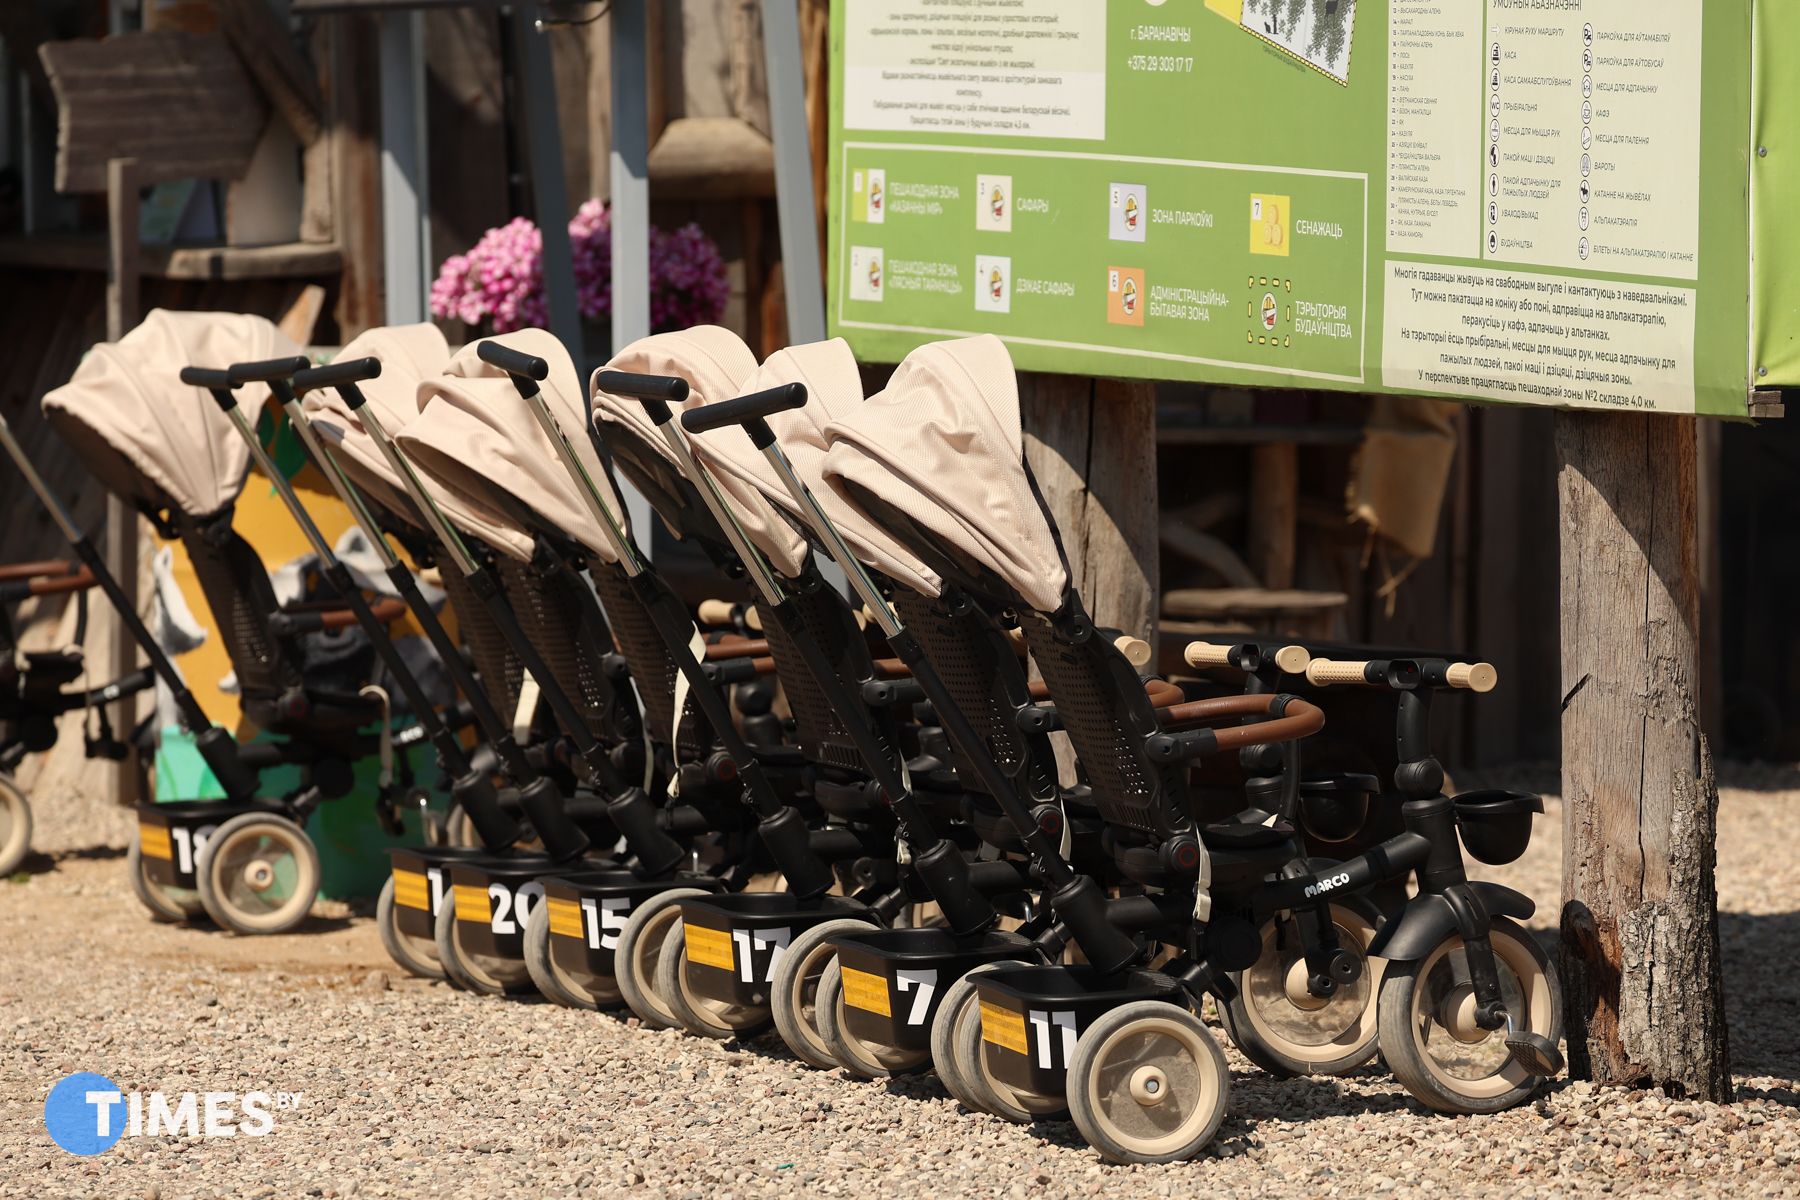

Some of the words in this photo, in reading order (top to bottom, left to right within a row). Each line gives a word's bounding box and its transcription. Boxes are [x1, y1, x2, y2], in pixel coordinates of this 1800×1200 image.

[1395, 266, 1417, 279] Многія
[1419, 271, 1455, 284] гадаванцы
[1457, 274, 1484, 287] жывуць
[1486, 277, 1494, 286] на
[1496, 277, 1535, 291] свабодным
[1537, 282, 1562, 295] выгуле
[1568, 285, 1616, 300] кантактуюць
[1623, 290, 1687, 305] наведвальнікамі.
[1411, 287, 1422, 302] Тут
[1424, 291, 1446, 302] можна
[1448, 294, 1483, 307] пакатацца
[1485, 298, 1494, 306] на
[1495, 297, 1518, 312] коніку
[1519, 299, 1532, 311] або
[1534, 301, 1550, 314] поні,
[1552, 304, 1594, 318] адправіцца
[1595, 309, 1604, 318] на
[1606, 310, 1666, 327] альпакатэрапію,
[1462, 315, 1500, 328] перакусіць
[1508, 318, 1526, 332] кафэ,
[1528, 322, 1564, 335] адпачыць
[1571, 326, 1610, 339] альтанках.
[1401, 327, 1410, 339] На
[1411, 331, 1446, 345] тэрыторыі
[1448, 332, 1464, 346] ёсць
[1466, 335, 1510, 352] прыбіральні,
[1512, 342, 1536, 354] месцы
[1537, 345, 1550, 355] для
[1552, 346, 1577, 358] мыцця
[1579, 349, 1593, 361] рук,
[1595, 351, 1618, 363] месца
[1620, 354, 1660, 369] адпачынку
[1662, 358, 1675, 369] для
[1440, 354, 1472, 366] пажылых
[1474, 357, 1502, 371] людзей,
[1504, 360, 1522, 372] пакоі
[1525, 362, 1541, 375] маці
[1546, 364, 1574, 379] дзіцяці,
[1575, 367, 1610, 381] дзіцячыя
[1611, 373, 1632, 384] зоны.
[1425, 372, 1470, 385] перспектыве
[1471, 377, 1517, 392] працягласць
[1518, 383, 1562, 396] пешаходнай
[1564, 389, 1583, 399] зоны
[1585, 388, 1598, 401] №2
[1599, 393, 1629, 405] складзе
[1631, 394, 1642, 408] 4,0
[1644, 398, 1656, 408] км.
[1305, 872, 1350, 898] MARCO
[582, 898, 630, 950] 15
[733, 927, 791, 982] 17
[897, 970, 937, 1025] 7
[1030, 1010, 1076, 1069] 11
